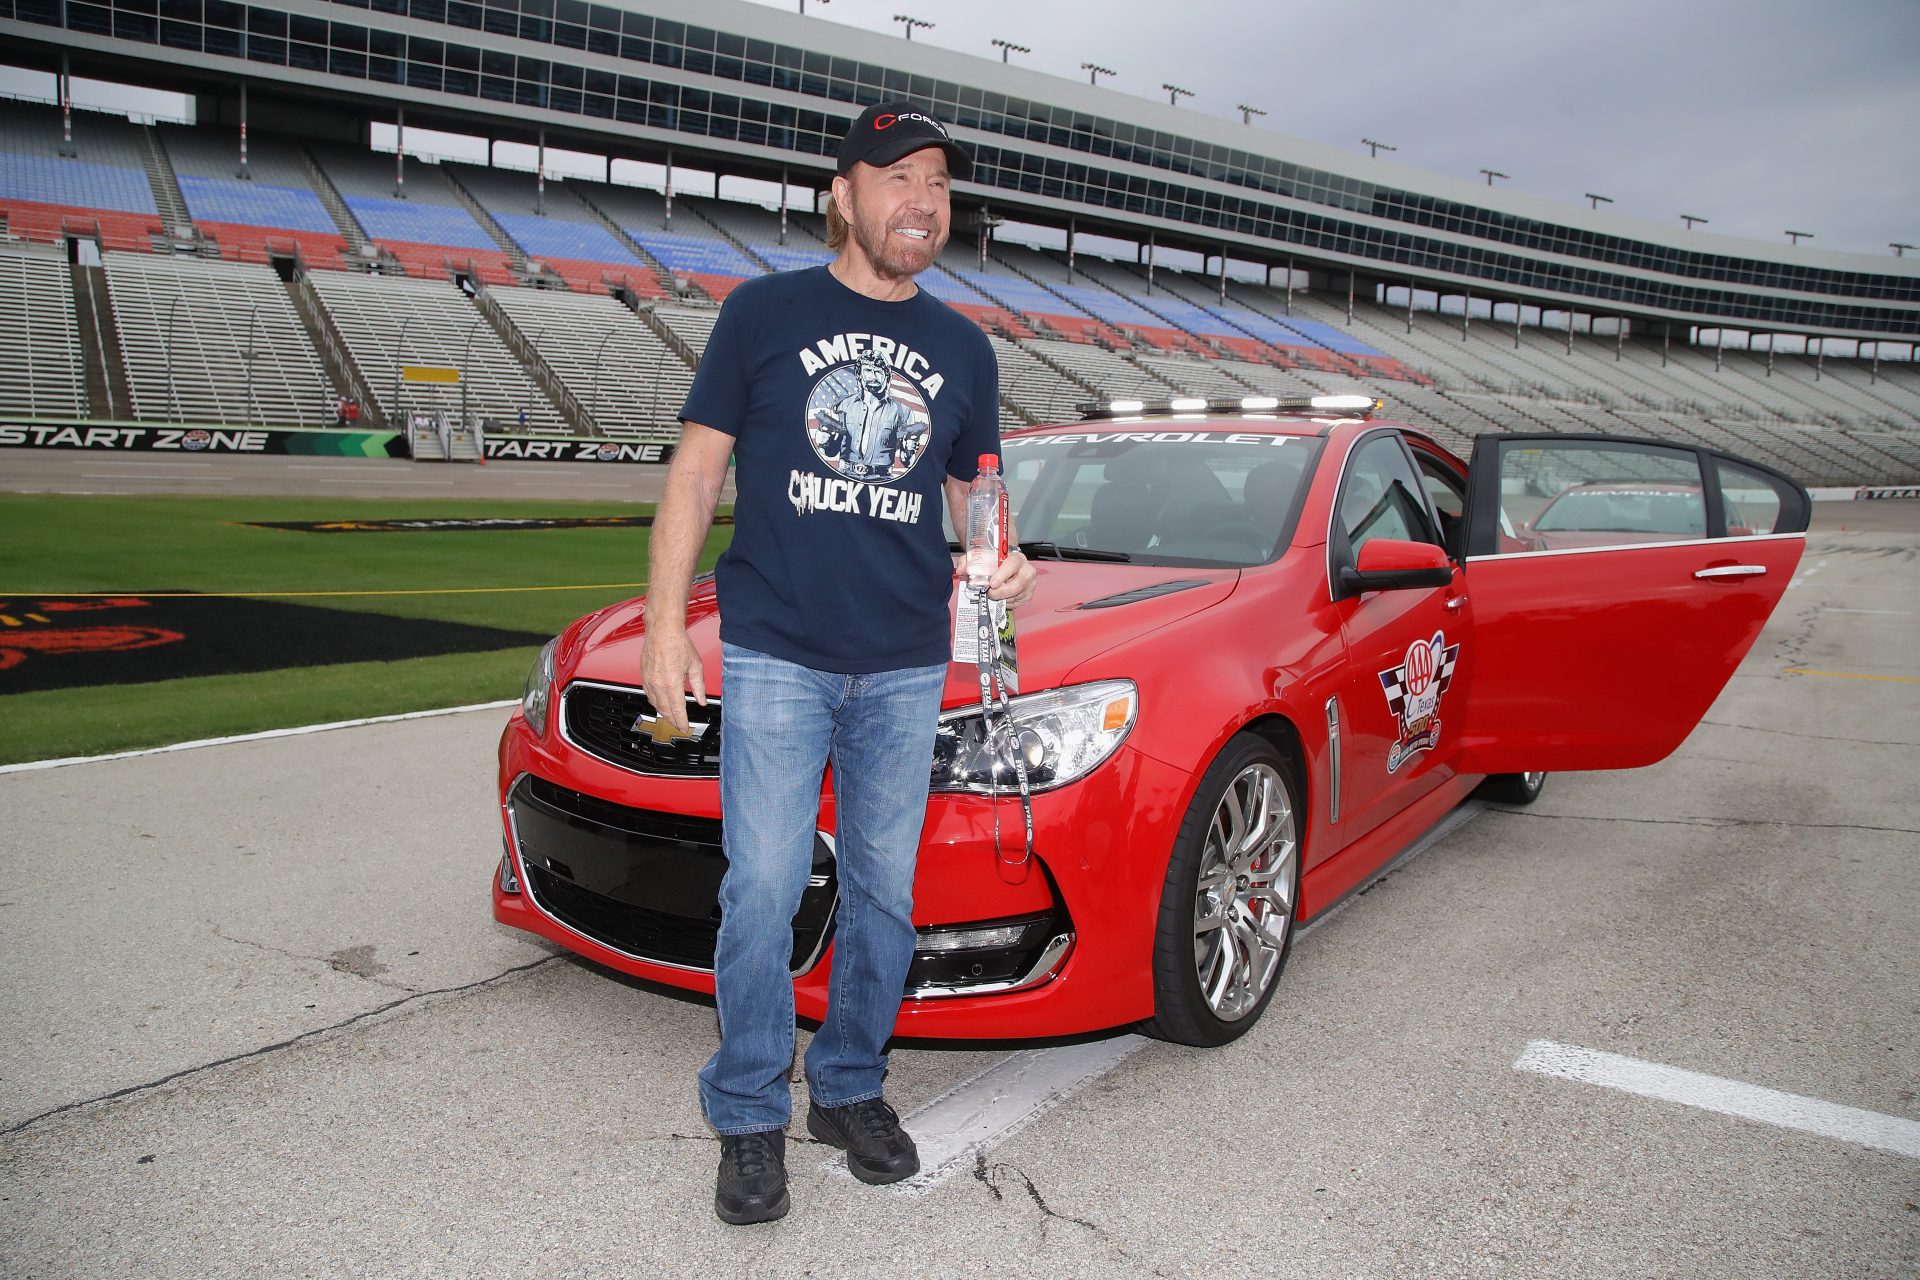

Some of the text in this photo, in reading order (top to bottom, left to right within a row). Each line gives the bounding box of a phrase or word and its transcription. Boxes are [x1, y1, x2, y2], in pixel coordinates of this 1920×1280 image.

[799, 333, 945, 400] AMERICA
[0, 425, 269, 450] START ZONE
[1000, 432, 1301, 447] CHEVROLET
[484, 440, 663, 461] TART ZONE
[788, 469, 922, 524] CHUCK YEAH!
[982, 640, 990, 663] TEXAS
[1409, 644, 1431, 691] AAA
[983, 686, 992, 710] TEXAS
[1417, 696, 1435, 715] Texas
[1408, 714, 1430, 739] 500
[1016, 759, 1026, 781] TEXAS
